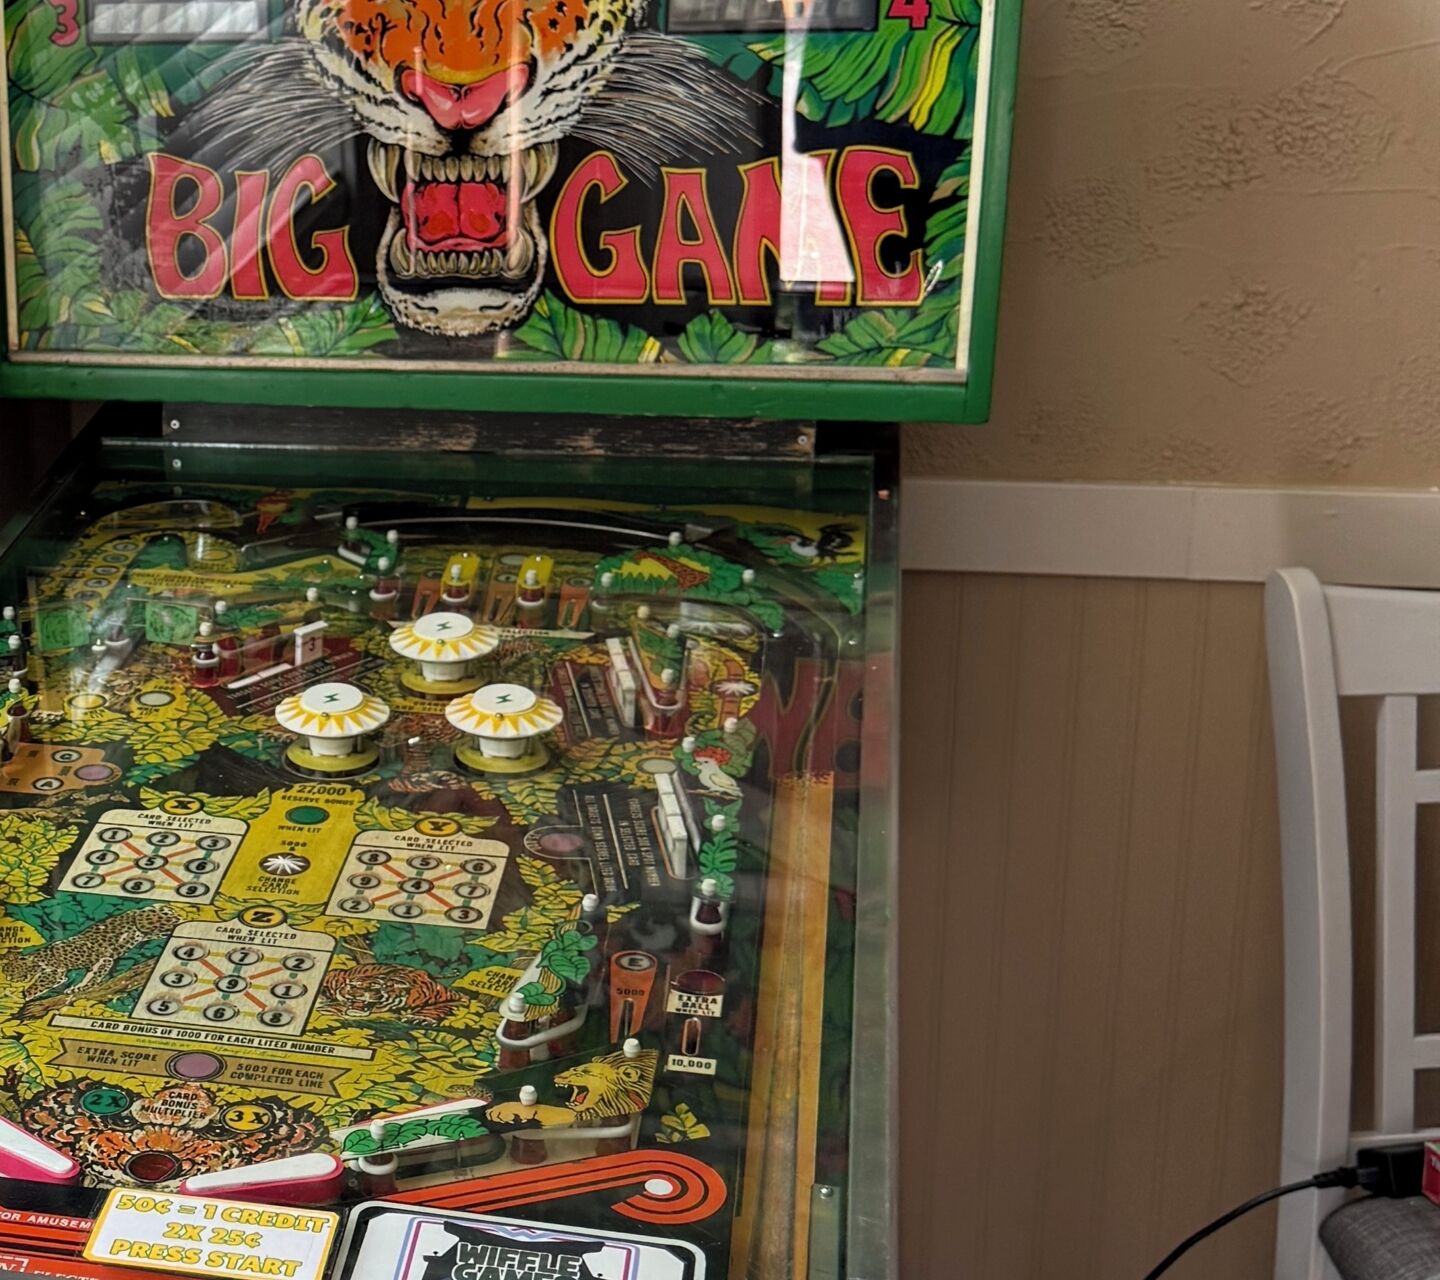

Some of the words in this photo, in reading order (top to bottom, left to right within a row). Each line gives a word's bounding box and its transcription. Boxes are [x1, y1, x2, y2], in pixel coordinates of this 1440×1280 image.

[146, 152, 359, 303] BIG
[552, 145, 926, 307] GAME
[296, 785, 346, 796] 27,000
[282, 795, 320, 803] RESERVE
[171, 800, 195, 810] X
[137, 813, 162, 821] CARD
[165, 816, 212, 825] SELECTED
[148, 820, 173, 828] WHEN
[428, 821, 451, 831] Y
[406, 842, 434, 850] WHEN
[425, 838, 473, 847] SELECTED
[258, 876, 297, 885] CHANGE
[246, 885, 301, 895] SELECTION
[251, 911, 276, 923] Z
[215, 926, 242, 934] CARD
[248, 930, 297, 940] SELECTED
[227, 934, 255, 943] WHEN
[628, 957, 643, 967] E
[486, 970, 521, 981] CHANG
[468, 979, 512, 993] SELECT
[616, 987, 645, 996] 5000
[678, 995, 718, 1004] EXTRA
[681, 1002, 710, 1010] BALL
[91, 1020, 119, 1031] CARD
[123, 1024, 159, 1036] BONUS
[160, 1028, 174, 1036] OF
[176, 1029, 202, 1039] 1000
[205, 1031, 224, 1042] FOR
[227, 1034, 255, 1045] EACH
[258, 1038, 288, 1049] LITED
[290, 1041, 336, 1054] NUMBER
[77, 1046, 116, 1058] EXTRA
[120, 1050, 158, 1062] SCORE
[86, 1054, 118, 1066] WHEN
[122, 1058, 141, 1068] LIT
[272, 1067, 292, 1076] FOR
[295, 1070, 324, 1079] EACH
[230, 1071, 293, 1084] COMPLETED
[299, 1080, 324, 1088] LINE
[168, 1091, 198, 1102] CARD
[161, 1099, 199, 1110] BONUS
[140, 1104, 207, 1120] MULTIPLIER
[116, 1194, 174, 1215] 50¢
[204, 1204, 218, 1220] 1
[220, 1207, 330, 1234] CREDIT
[26, 1214, 93, 1230] AMUSEM
[162, 1222, 206, 1242] 2X
[207, 1226, 263, 1248] 25¢
[109, 1239, 203, 1265] PRESS
[205, 1249, 303, 1278] START
[457, 1241, 582, 1276] WIFFLE
